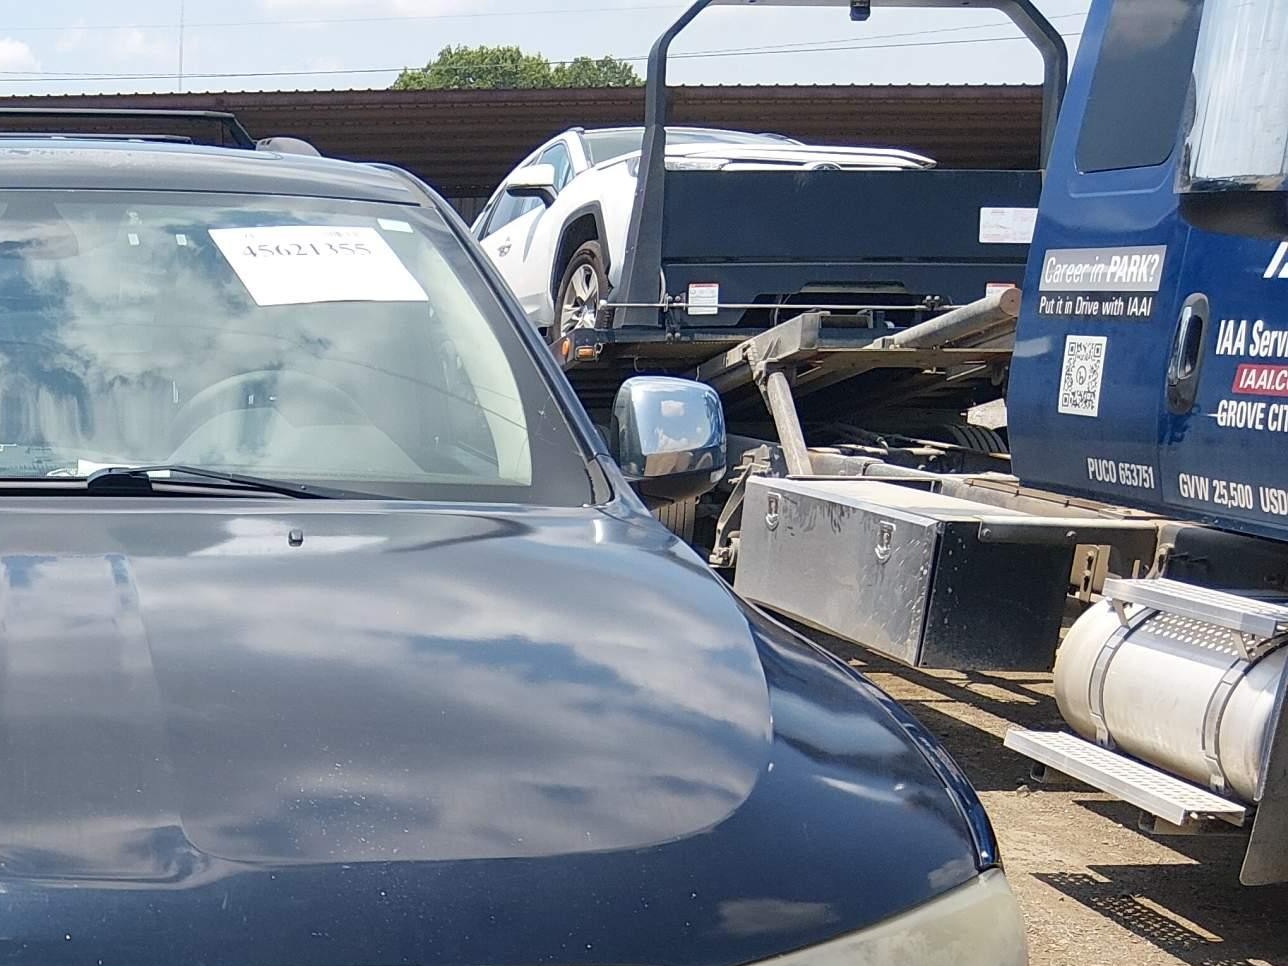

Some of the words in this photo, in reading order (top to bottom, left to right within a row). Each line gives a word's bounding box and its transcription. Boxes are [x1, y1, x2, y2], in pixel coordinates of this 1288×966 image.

[242, 242, 372, 258] 45621355
[1044, 257, 1090, 283] Career
[1089, 255, 1105, 283] in
[1106, 253, 1160, 283] PARK?
[1039, 295, 1054, 314] Put
[1055, 295, 1064, 314] it
[1064, 295, 1073, 315] in
[1075, 296, 1099, 315] Drive
[1101, 296, 1124, 316] with
[1127, 296, 1153, 317] IAAI
[1216, 319, 1247, 356] IAA
[1239, 368, 1288, 391] IAAI.C
[1217, 399, 1266, 430] GROVE
[1087, 457, 1117, 483] PUCO
[1118, 462, 1155, 489] 653751
[1179, 472, 1209, 501] GVW
[1212, 479, 1254, 509] 25,500
[1259, 486, 1288, 516] USD
